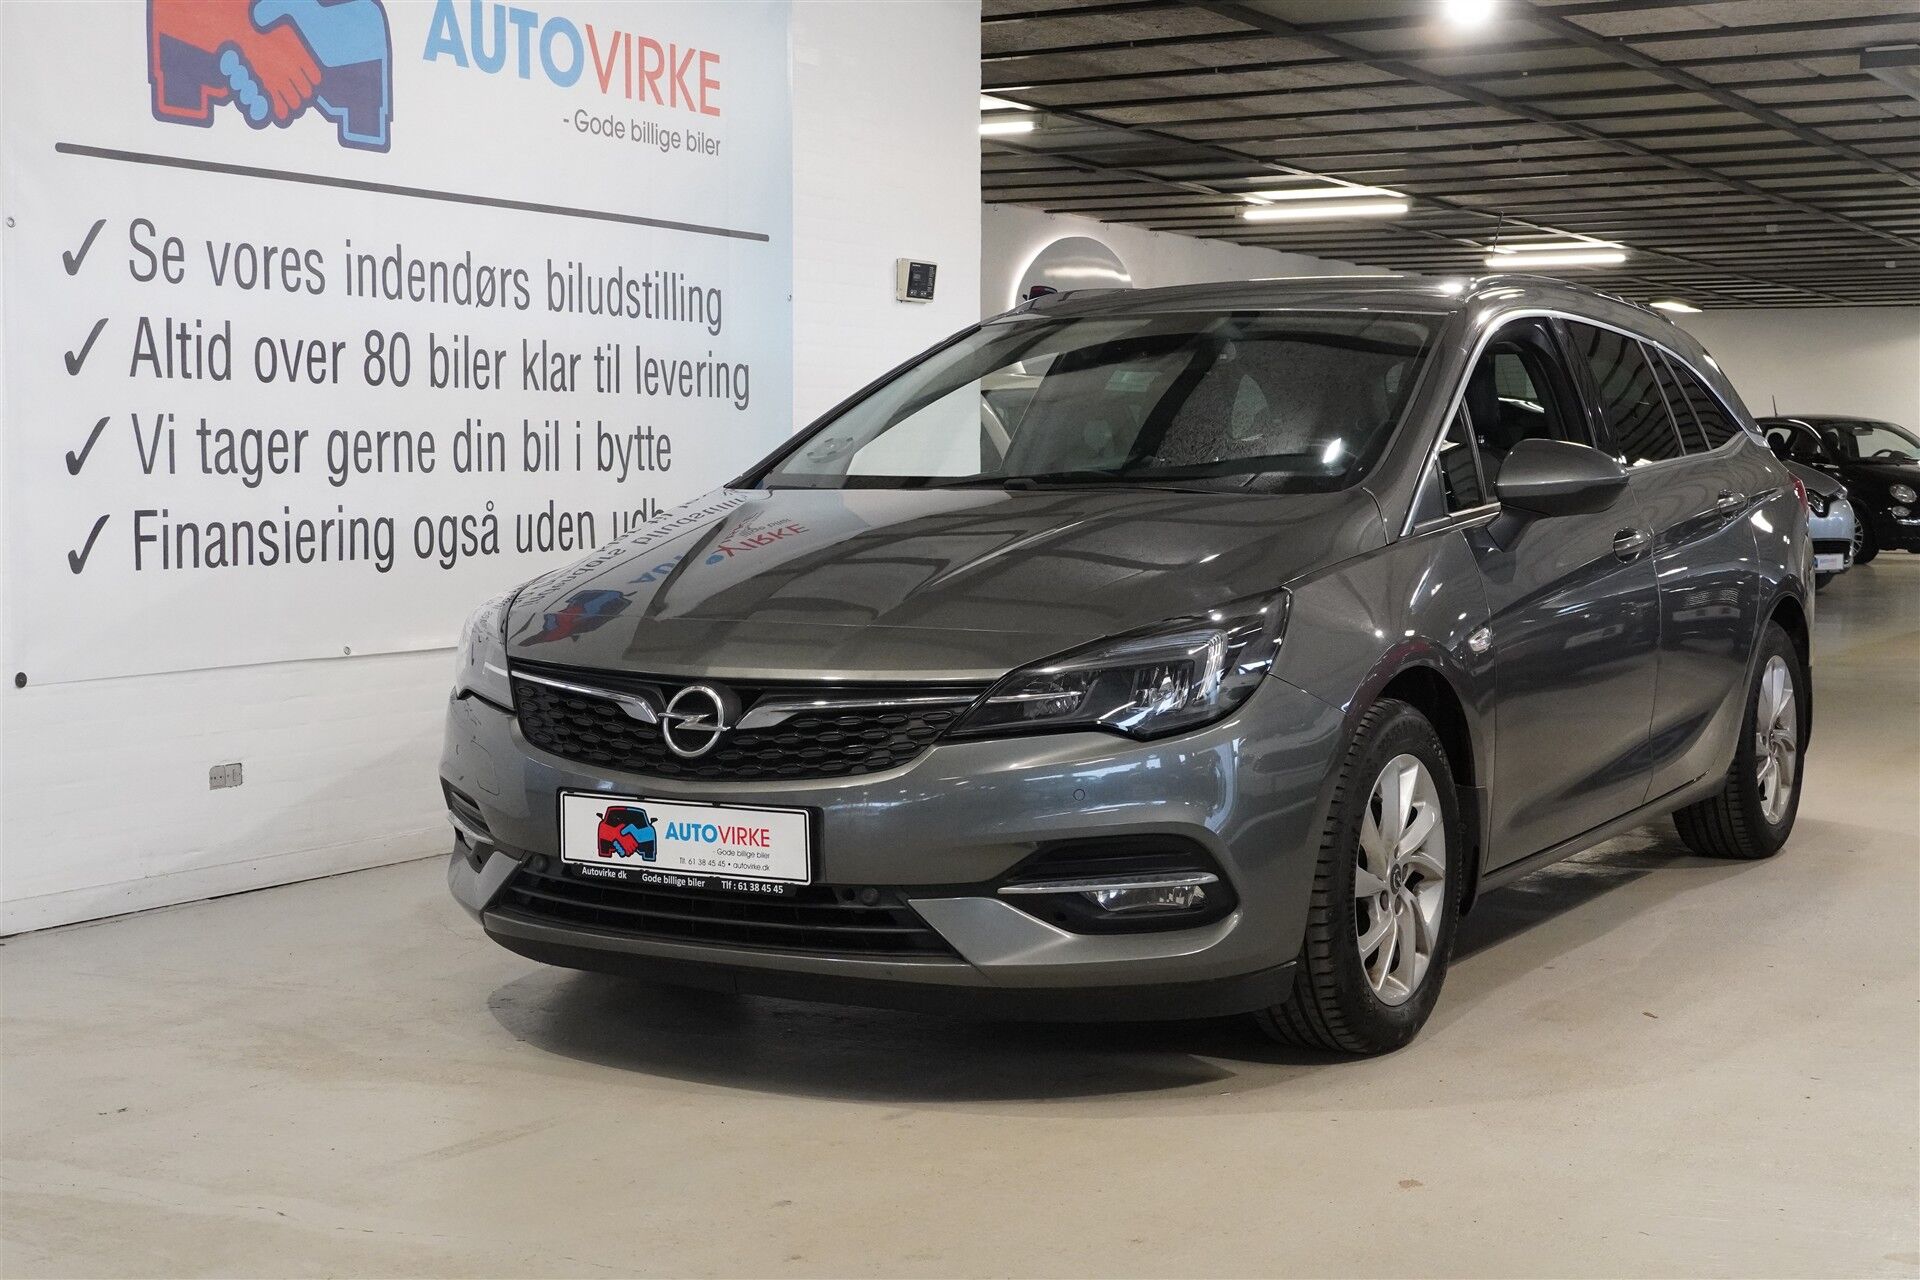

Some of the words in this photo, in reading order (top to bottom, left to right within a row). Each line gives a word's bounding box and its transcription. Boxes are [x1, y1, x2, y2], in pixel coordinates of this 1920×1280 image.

[422, 0, 721, 117] AUTOVIRKE
[574, 108, 626, 140] Gode
[630, 118, 682, 153] billige
[686, 129, 721, 157] biler
[128, 217, 185, 285] Se
[205, 240, 326, 296] vores
[345, 238, 531, 311] indendørs
[546, 258, 722, 337] biludstilling
[129, 316, 232, 382] Altid
[254, 336, 347, 385] over
[363, 329, 411, 388] 80
[429, 332, 507, 391] biler
[522, 338, 582, 393] klar
[593, 343, 621, 394] til
[635, 345, 750, 411] levering
[130, 413, 176, 475] Vi
[195, 417, 310, 489] tager
[326, 429, 436, 488] gerne
[452, 418, 506, 473] din
[523, 419, 560, 473] bil
[575, 420, 581, 472] i
[597, 420, 672, 484] bytte
[133, 504, 395, 574] Finansiering
[413, 500, 500, 571] også
[516, 499, 596, 553] uden
[665, 821, 770, 848] AUTOVIRKE
[707, 859, 716, 867] 45
[717, 860, 726, 868] 45
[732, 862, 770, 872] autovirke.dk
[716, 848, 736, 857] Gode
[581, 866, 617, 878] Autovirke
[617, 870, 628, 880] dk
[641, 872, 662, 883] Gode
[663, 875, 686, 887] billige
[687, 878, 706, 888] biler
[721, 880, 733, 890] Tlf
[737, 882, 748, 891] 61
[749, 883, 760, 892] 38
[761, 884, 772, 893] 45
[772, 885, 784, 894] 45
